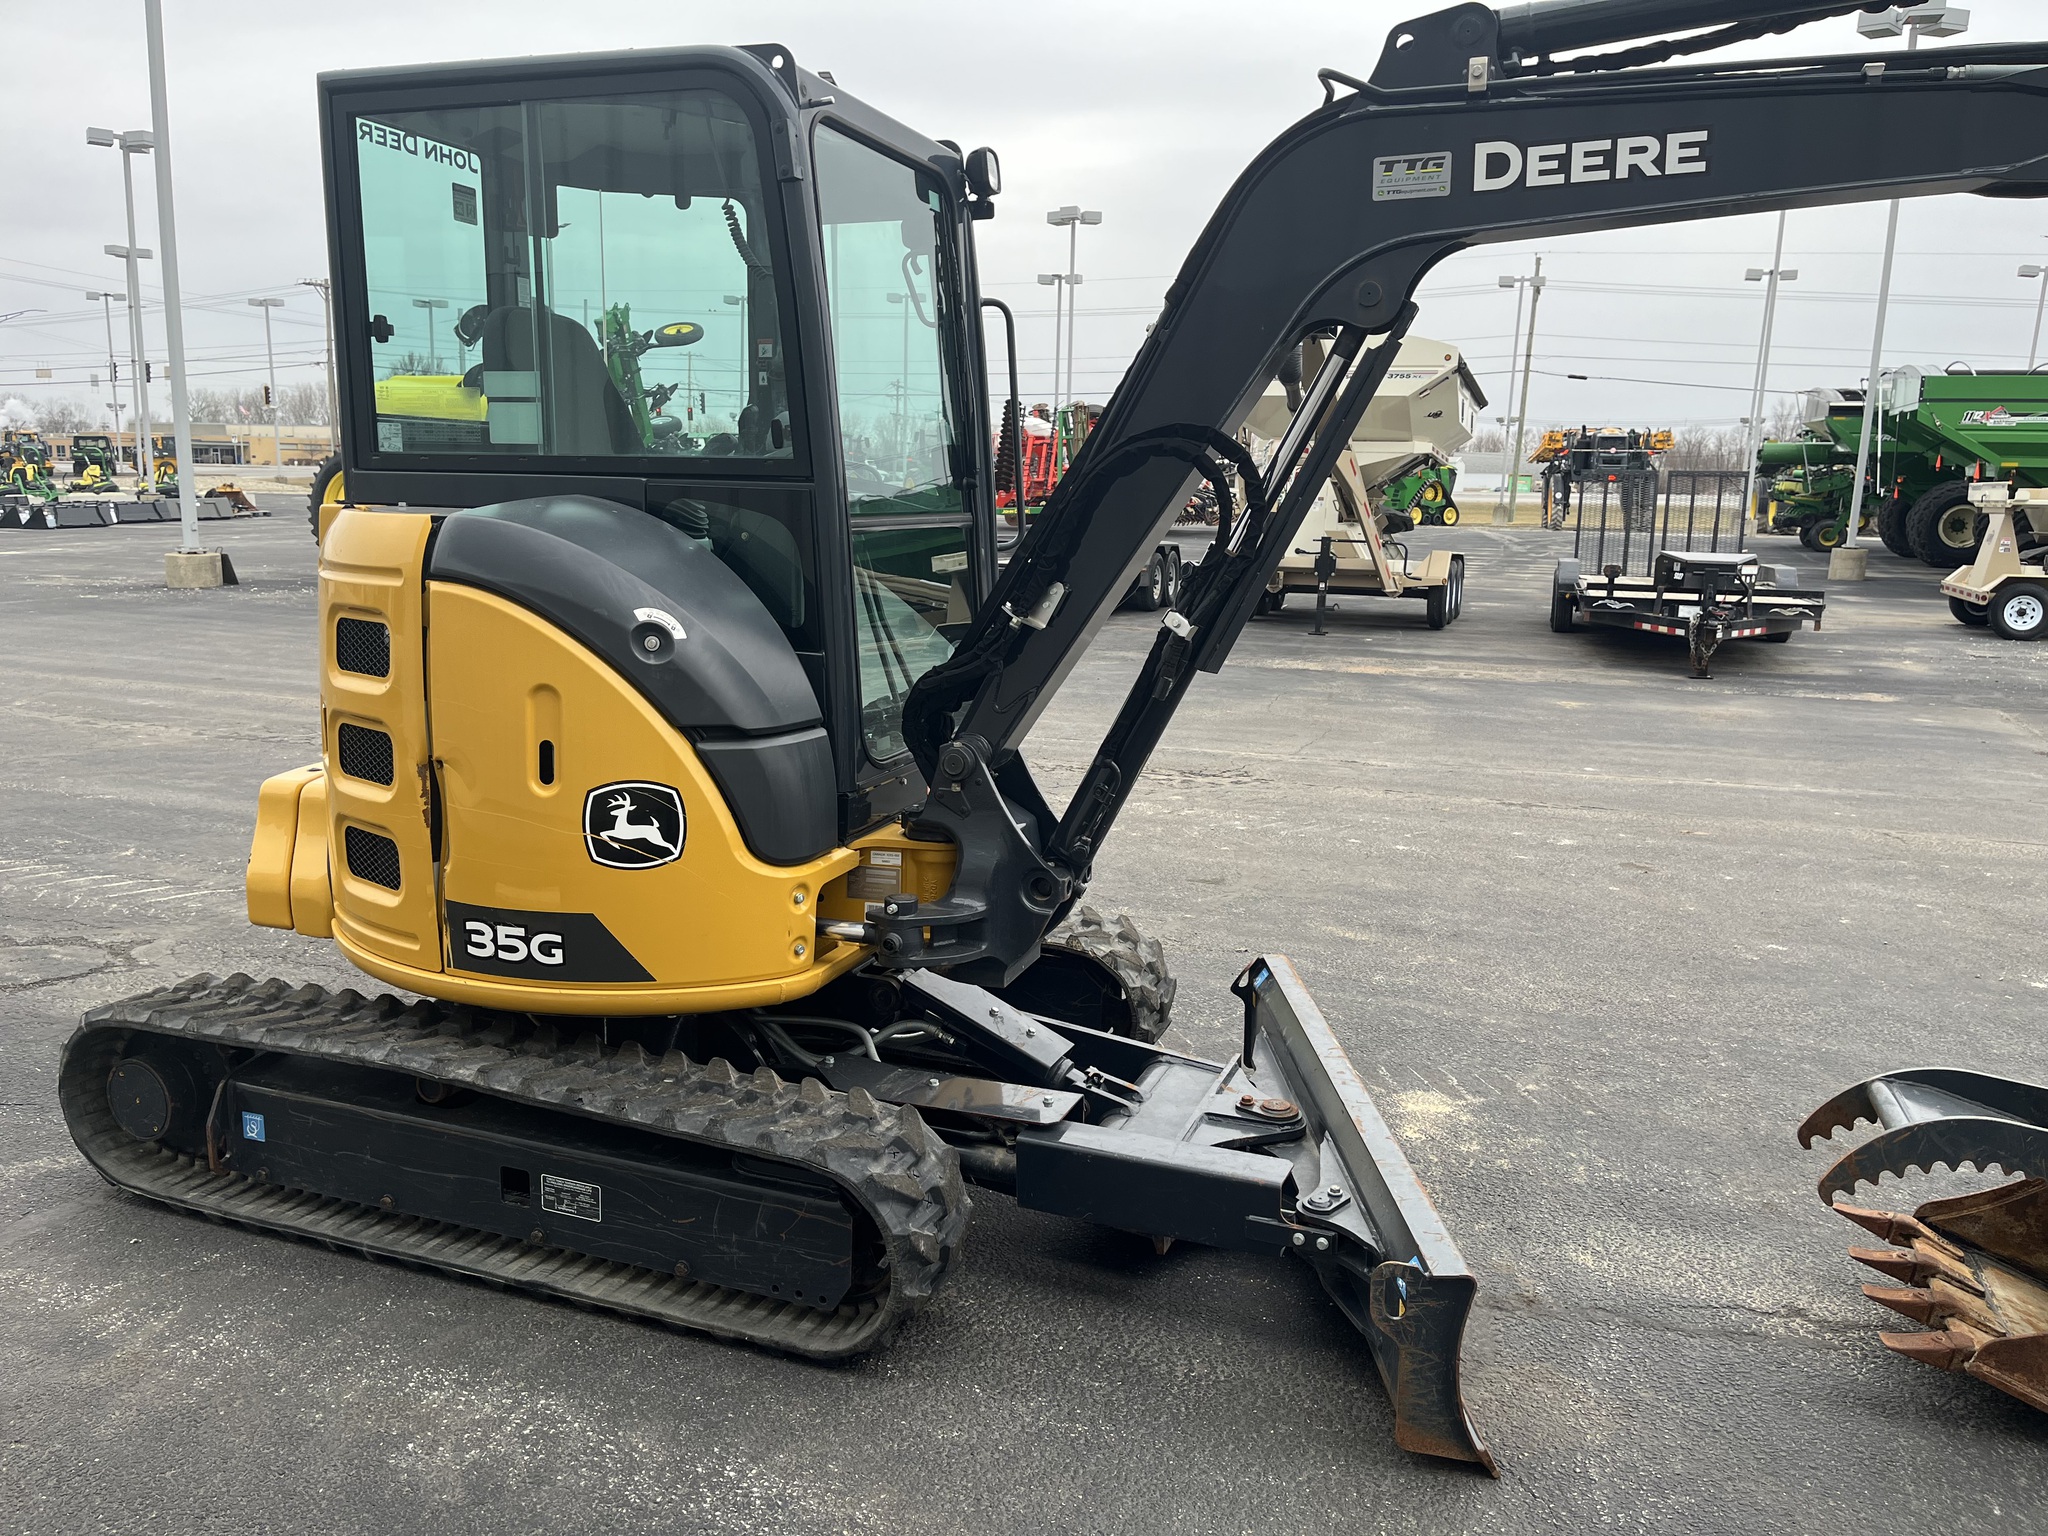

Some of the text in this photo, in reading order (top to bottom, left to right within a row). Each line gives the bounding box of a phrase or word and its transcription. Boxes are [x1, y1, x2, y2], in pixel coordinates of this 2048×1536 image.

[1379, 155, 1447, 177] TTG
[1472, 129, 1709, 193] DEERE
[1380, 174, 1442, 185] EQUIPMENT
[465, 920, 564, 965] 35G
